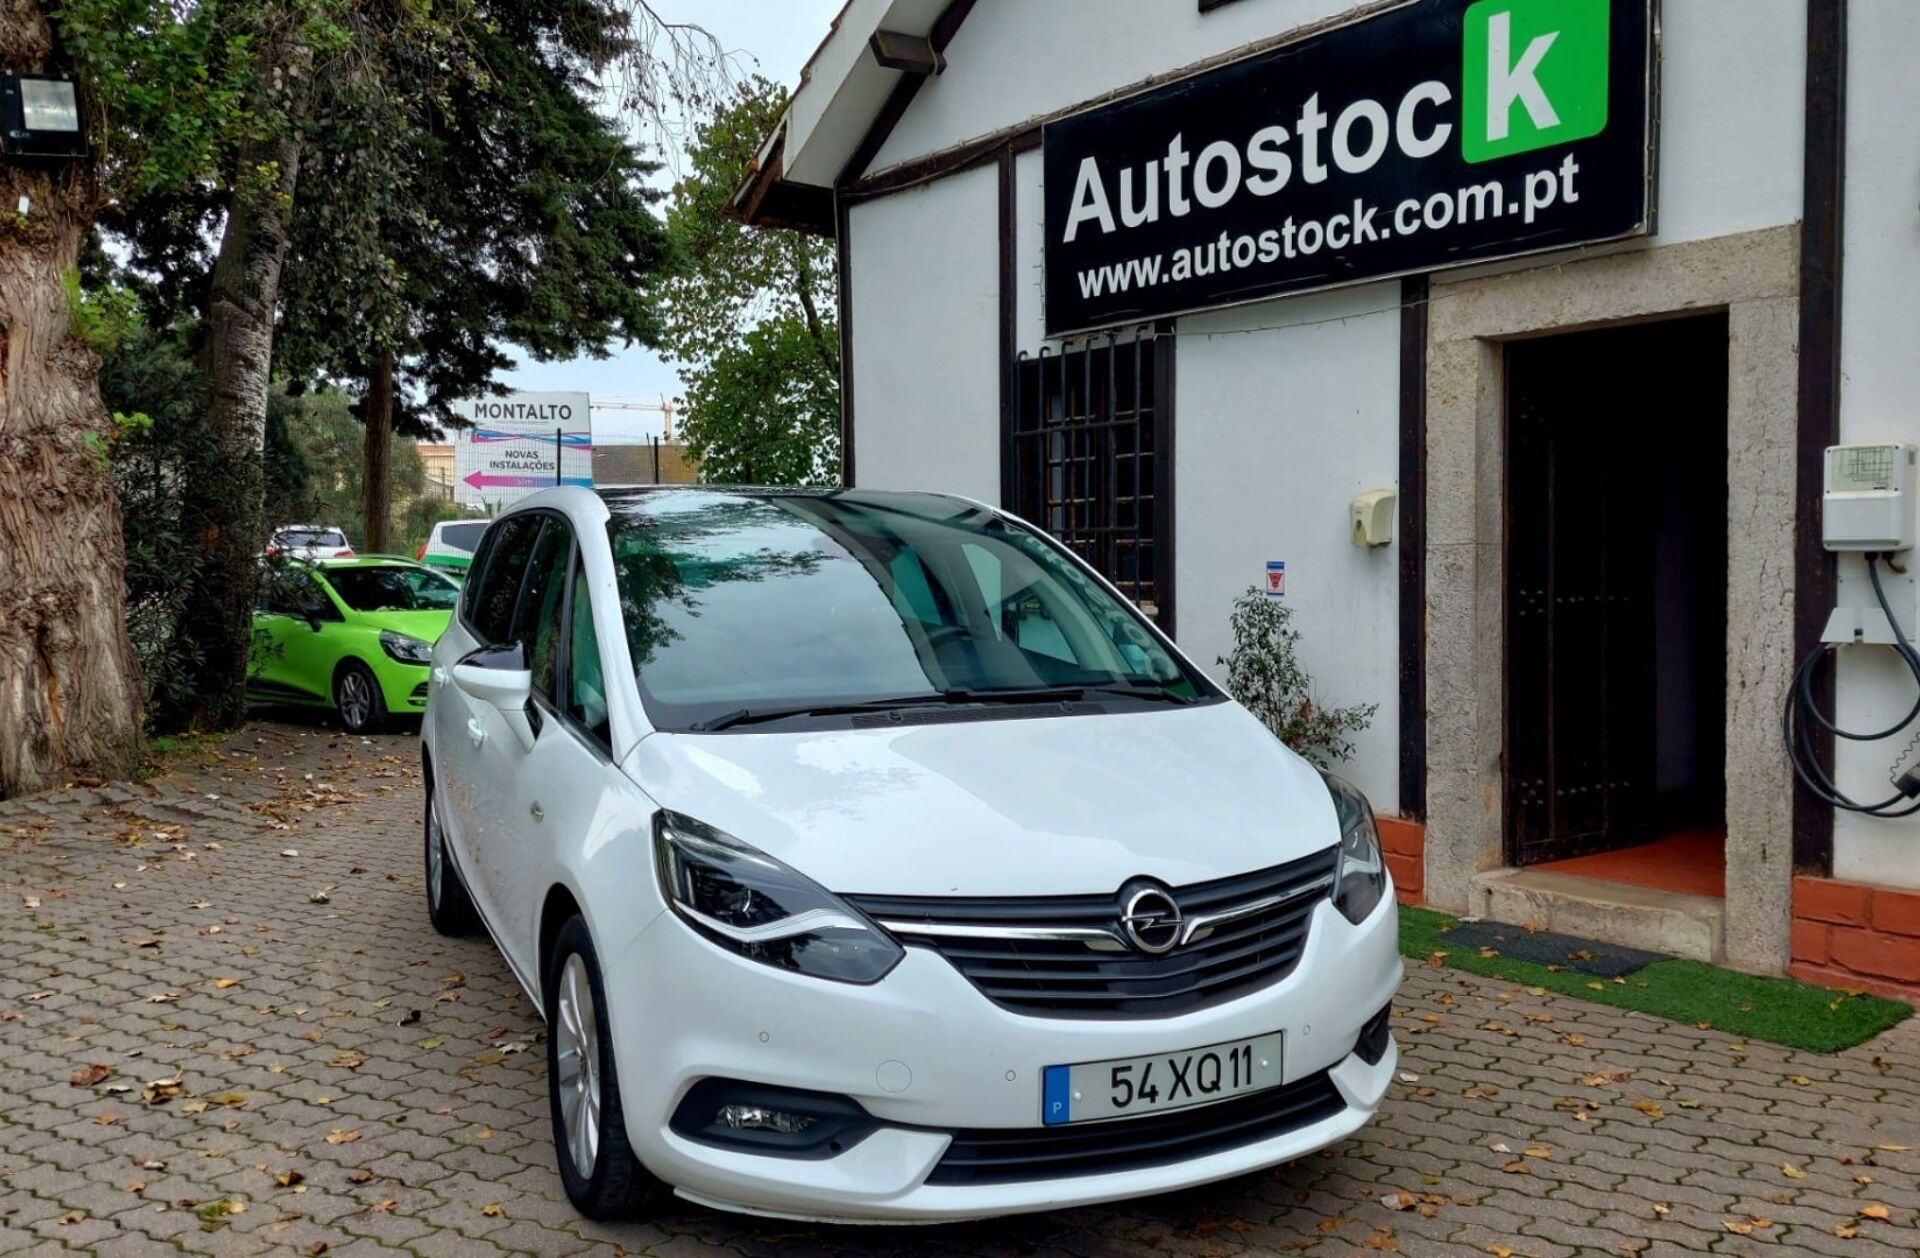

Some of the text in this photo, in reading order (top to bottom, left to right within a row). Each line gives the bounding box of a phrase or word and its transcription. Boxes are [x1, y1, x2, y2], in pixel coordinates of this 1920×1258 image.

[1063, 10, 1561, 243] Autostock
[1078, 153, 1580, 300] www.autostock.com.pt
[475, 403, 572, 420] MONTALTO
[505, 451, 538, 459] NOVAS
[489, 460, 555, 471] INSTALAÇÕES
[1052, 1101, 1062, 1114] P
